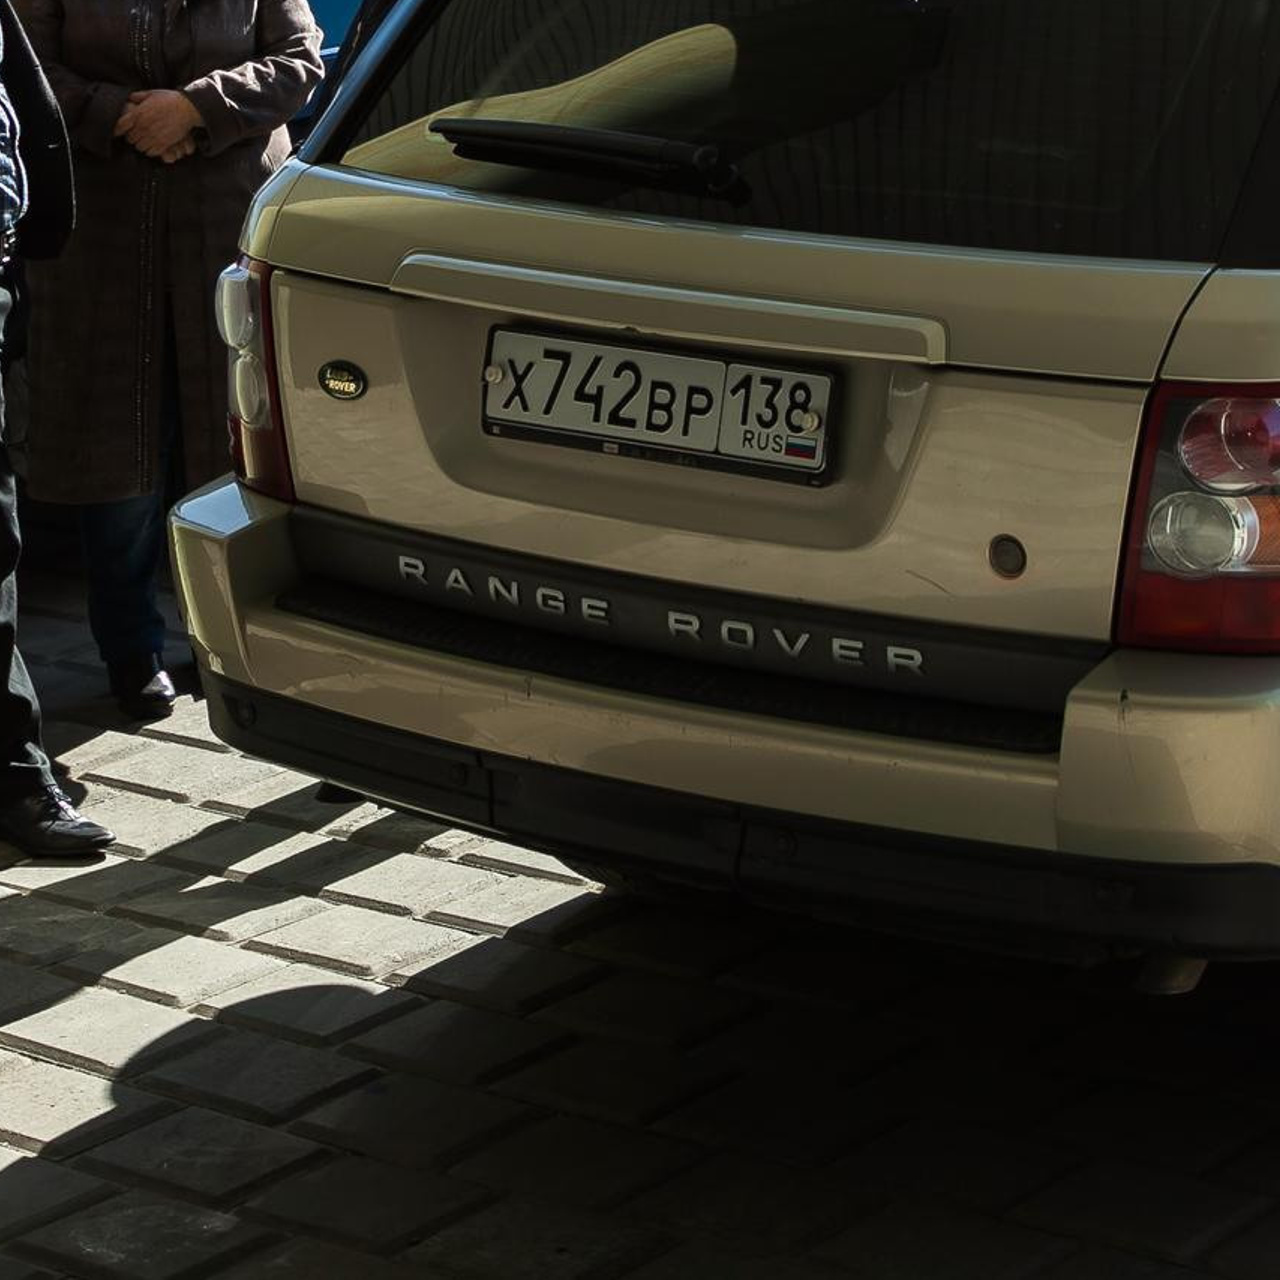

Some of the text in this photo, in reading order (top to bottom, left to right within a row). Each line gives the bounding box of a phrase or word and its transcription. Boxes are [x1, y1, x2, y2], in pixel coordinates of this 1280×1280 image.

[502, 348, 813, 437] Х742ВР 138
[742, 429, 783, 454] RUS
[399, 555, 924, 676] RANGE ROVER
